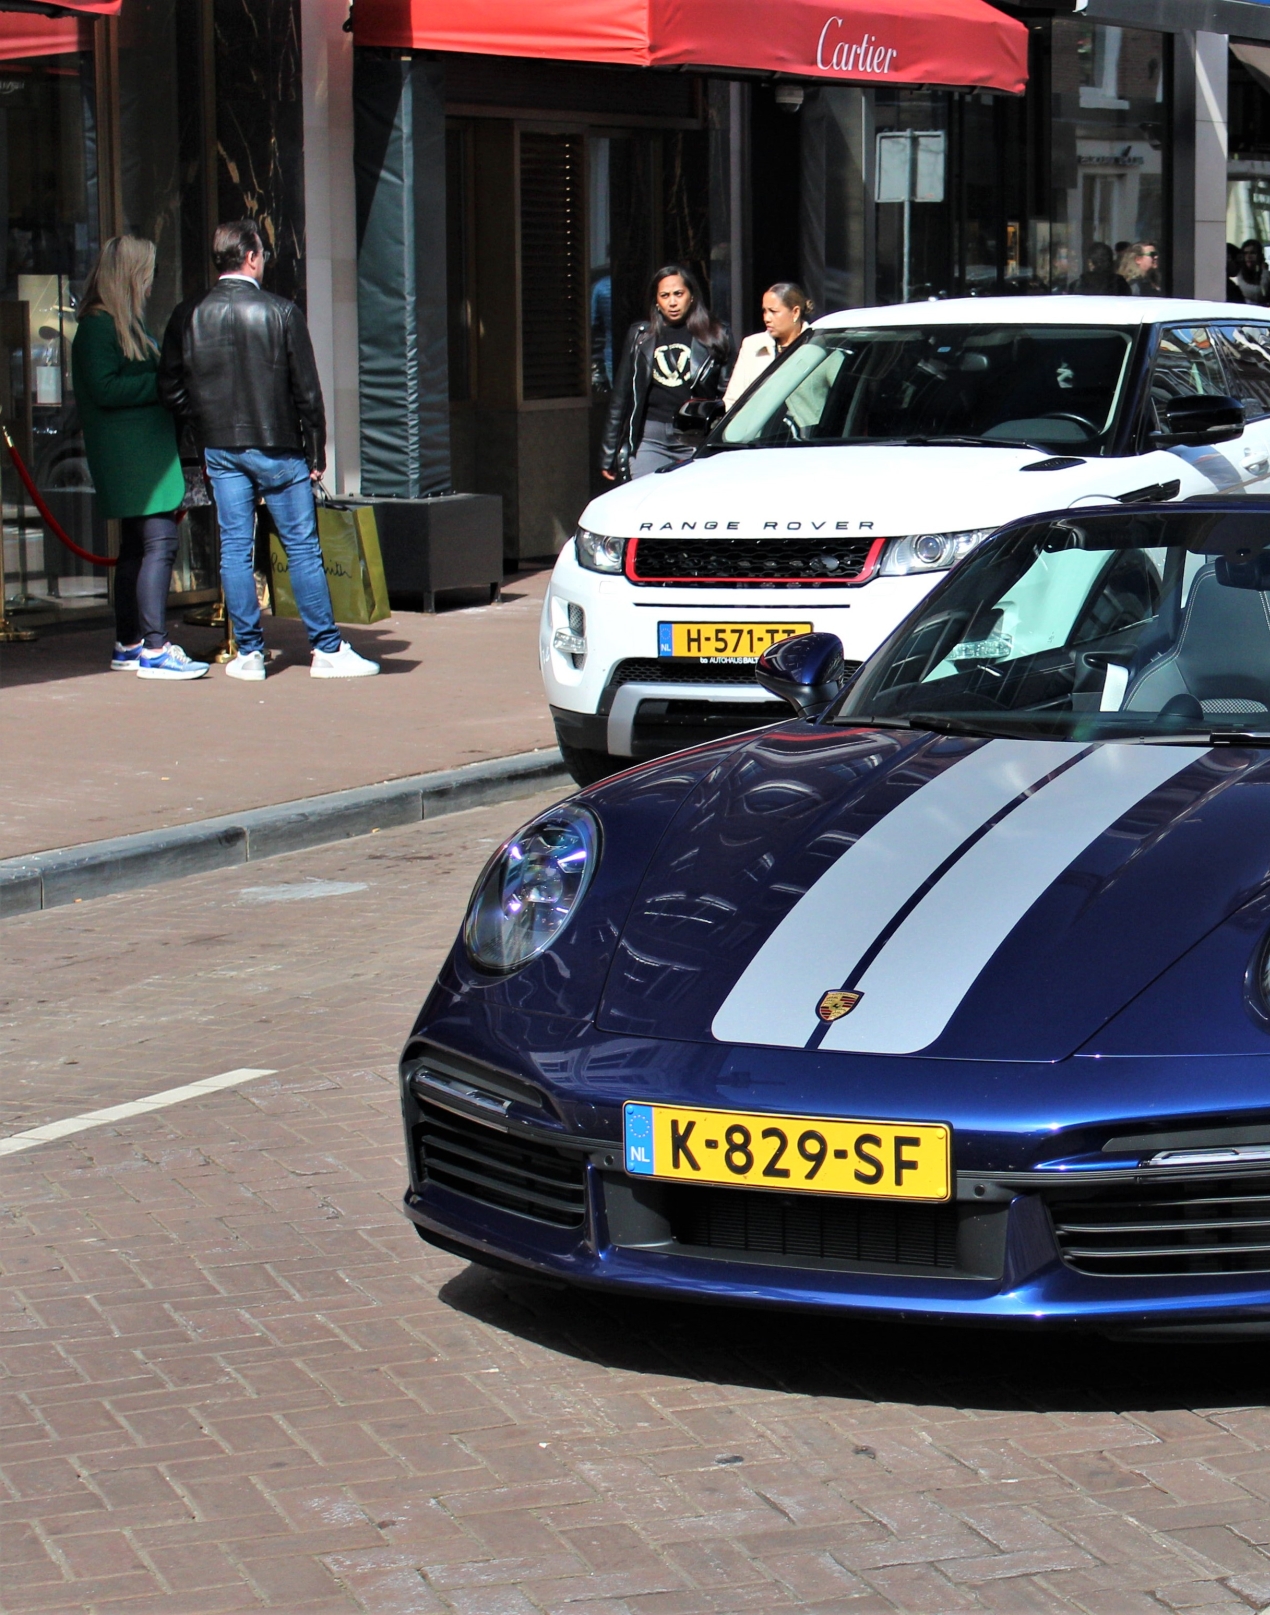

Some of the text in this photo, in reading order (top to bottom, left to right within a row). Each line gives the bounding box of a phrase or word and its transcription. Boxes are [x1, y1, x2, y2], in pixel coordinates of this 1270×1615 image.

[816, 16, 897, 74] Cartier
[639, 521, 874, 531] RANGE ROVER
[661, 644, 671, 652] NL
[630, 1146, 650, 1163] NL
[670, 1119, 921, 1186] K-829-SF
